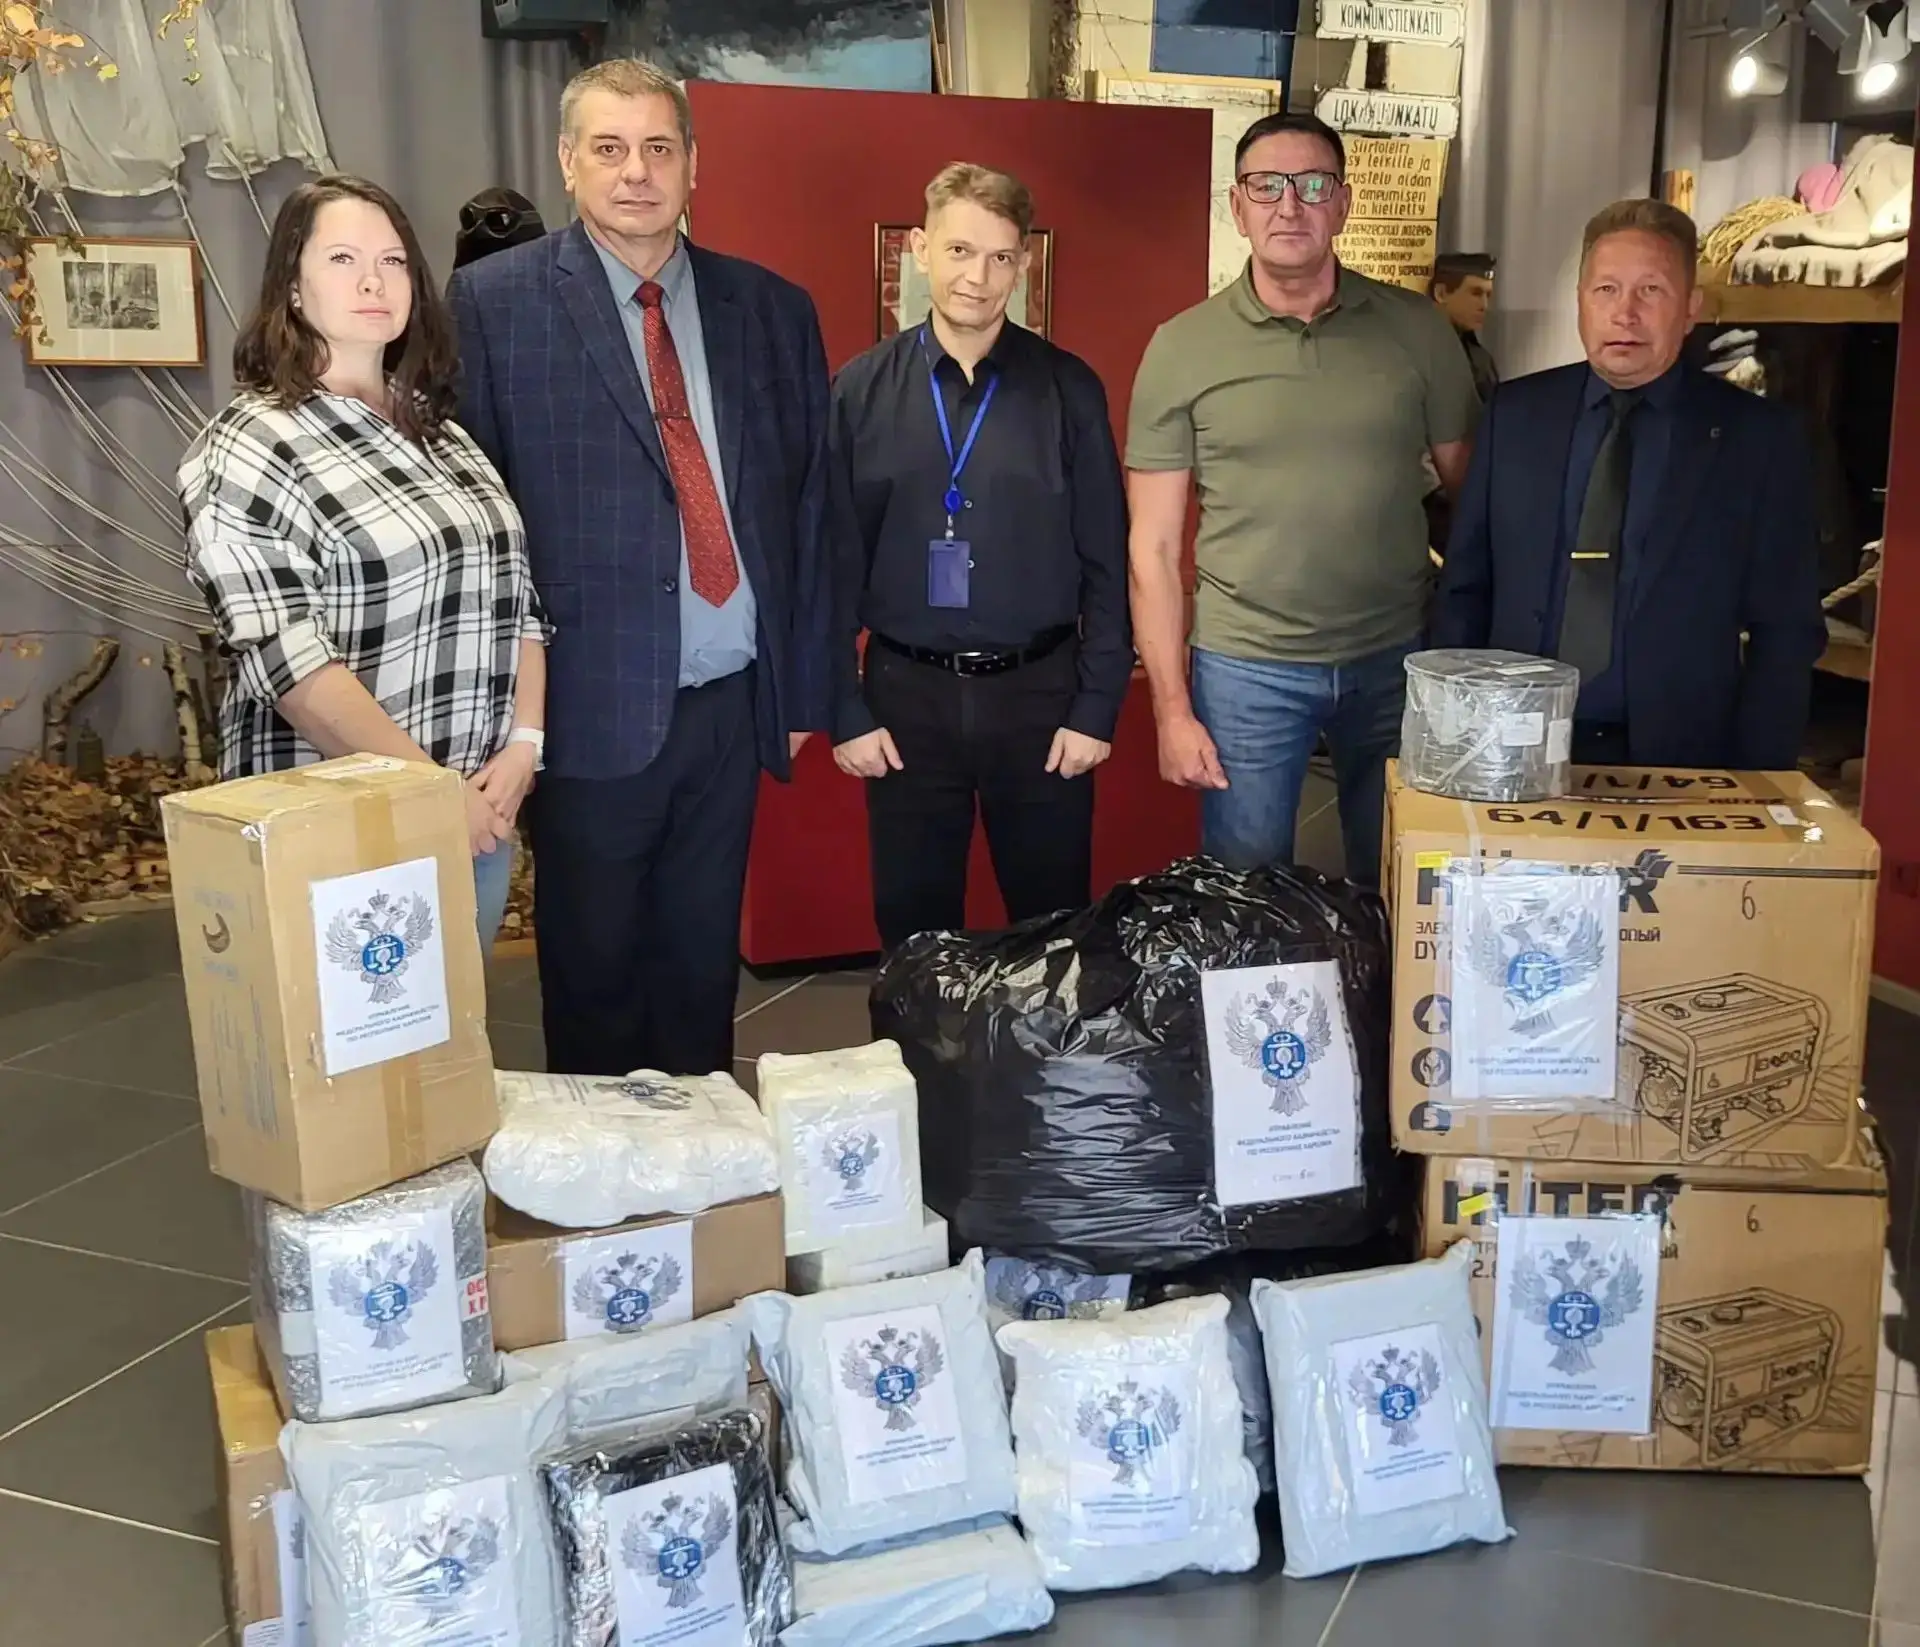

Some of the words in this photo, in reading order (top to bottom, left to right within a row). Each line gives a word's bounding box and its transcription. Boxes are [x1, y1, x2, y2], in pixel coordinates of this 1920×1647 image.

[1341, 4, 1442, 35] KOMMUNISTIENKATU
[1347, 155, 1361, 167] sy
[1418, 155, 1431, 172] ja
[1347, 171, 1392, 185] rustelu
[1487, 808, 1767, 832] 64/1/163
[1746, 1204, 1760, 1233] 6
